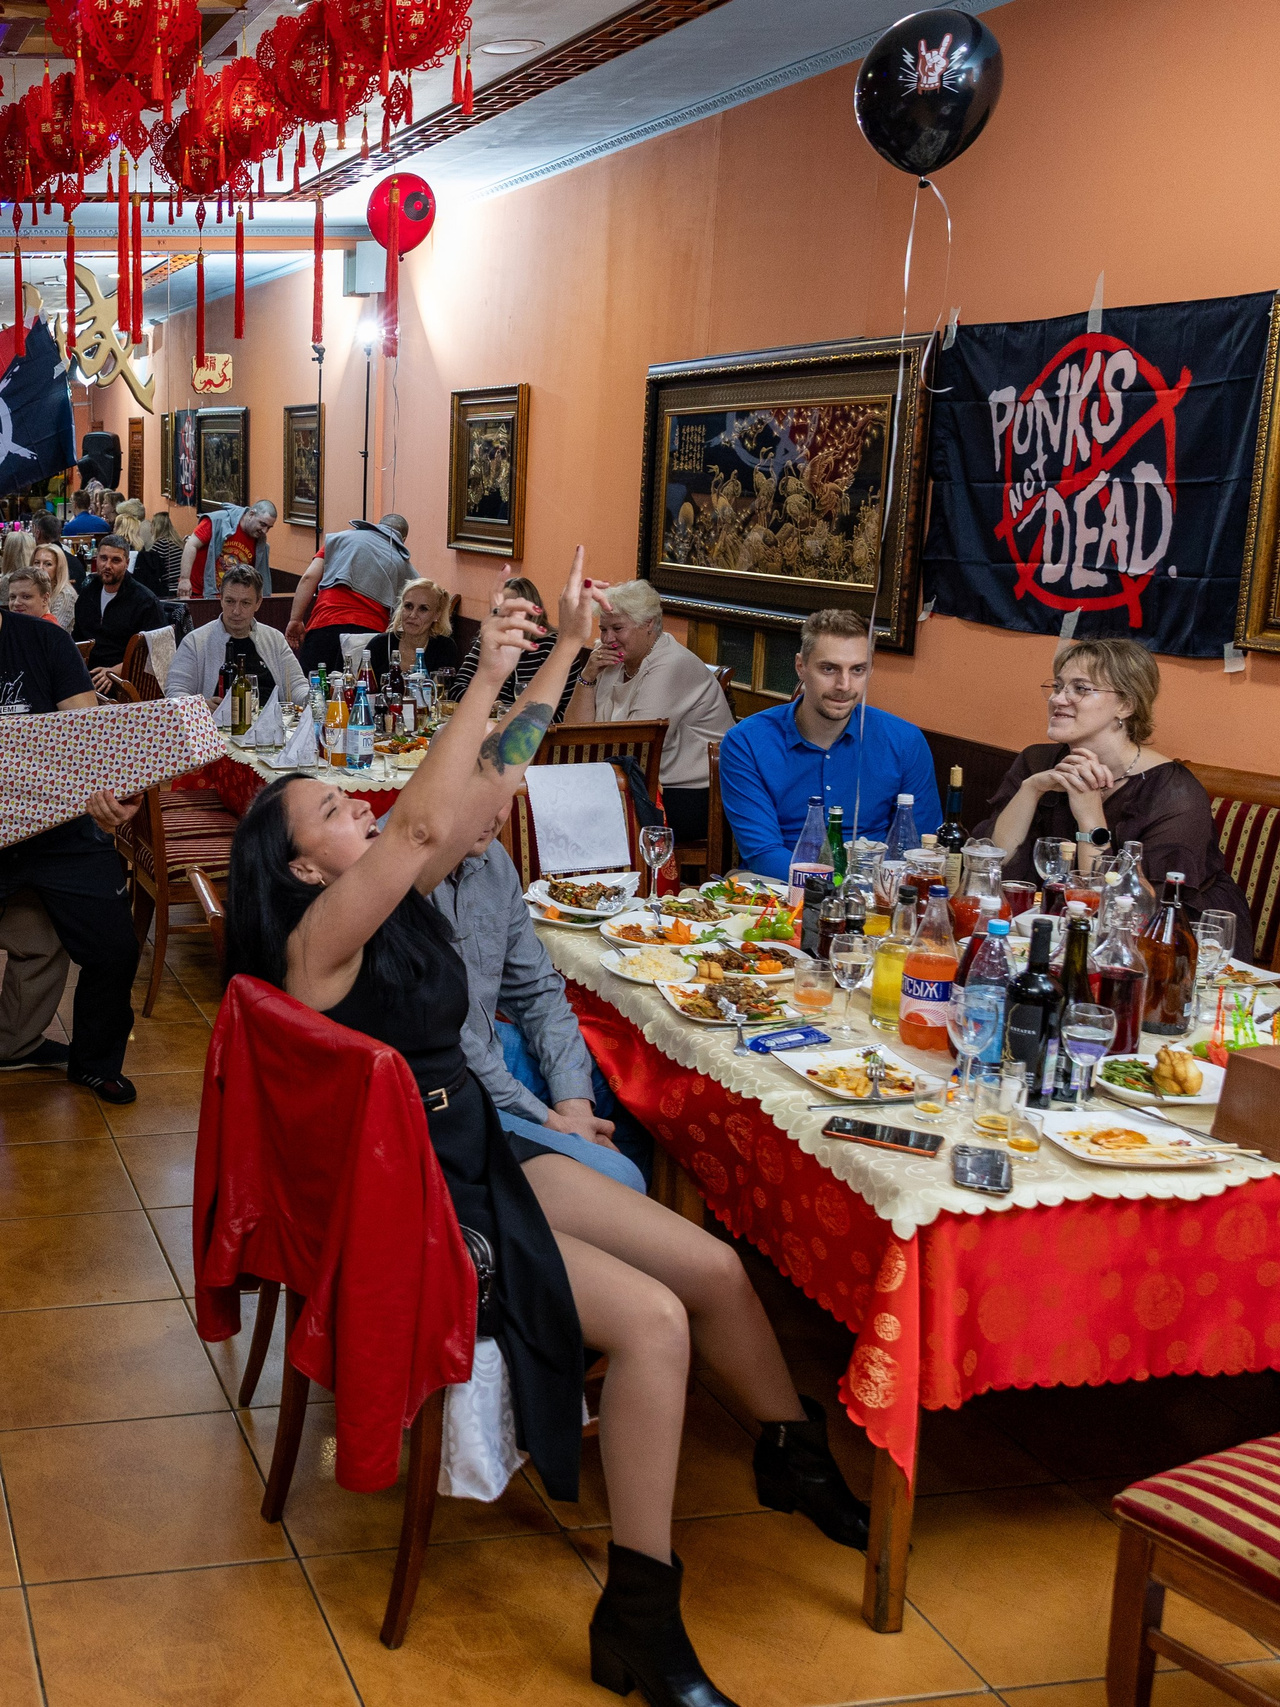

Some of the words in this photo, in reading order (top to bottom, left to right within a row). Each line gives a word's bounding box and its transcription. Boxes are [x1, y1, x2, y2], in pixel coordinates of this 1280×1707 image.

[110, 10, 127, 28] 年
[409, 9, 425, 26] 福
[988, 349, 1137, 472] PUNKS
[1009, 453, 1048, 518] NOT
[1040, 460, 1178, 590] DEAD.
